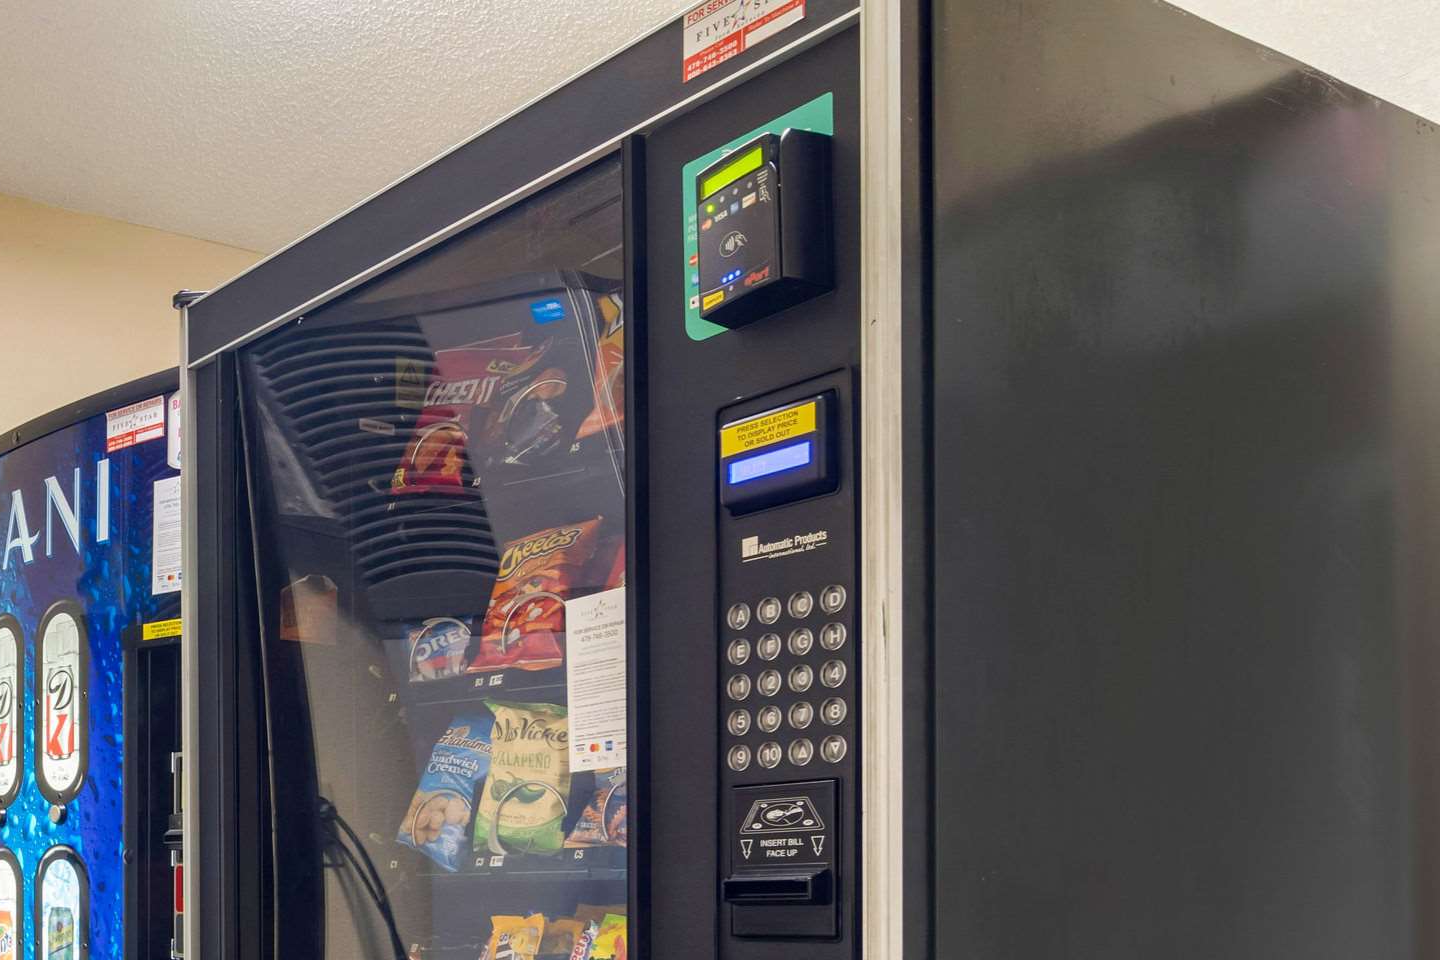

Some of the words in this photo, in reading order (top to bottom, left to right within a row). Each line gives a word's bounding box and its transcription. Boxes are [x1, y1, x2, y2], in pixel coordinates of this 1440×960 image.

[688, 9, 705, 24] FOR
[696, 15, 730, 42] FIVE
[736, 422, 759, 433] PRESS
[760, 410, 799, 427] SELECTION
[747, 424, 776, 438] DISPLAY
[777, 418, 799, 430] PRICE
[744, 439, 755, 448] OR
[756, 433, 775, 445] SOLD
[775, 428, 791, 439] OUT
[759, 537, 794, 554] Automatic
[794, 530, 828, 546] Products
[501, 530, 579, 577] Cheetos
[432, 752, 479, 772] Sandwich
[760, 839, 788, 848] INSERT
[788, 838, 804, 846] BILL
[766, 849, 786, 857] FACE
[787, 848, 798, 857] UP
